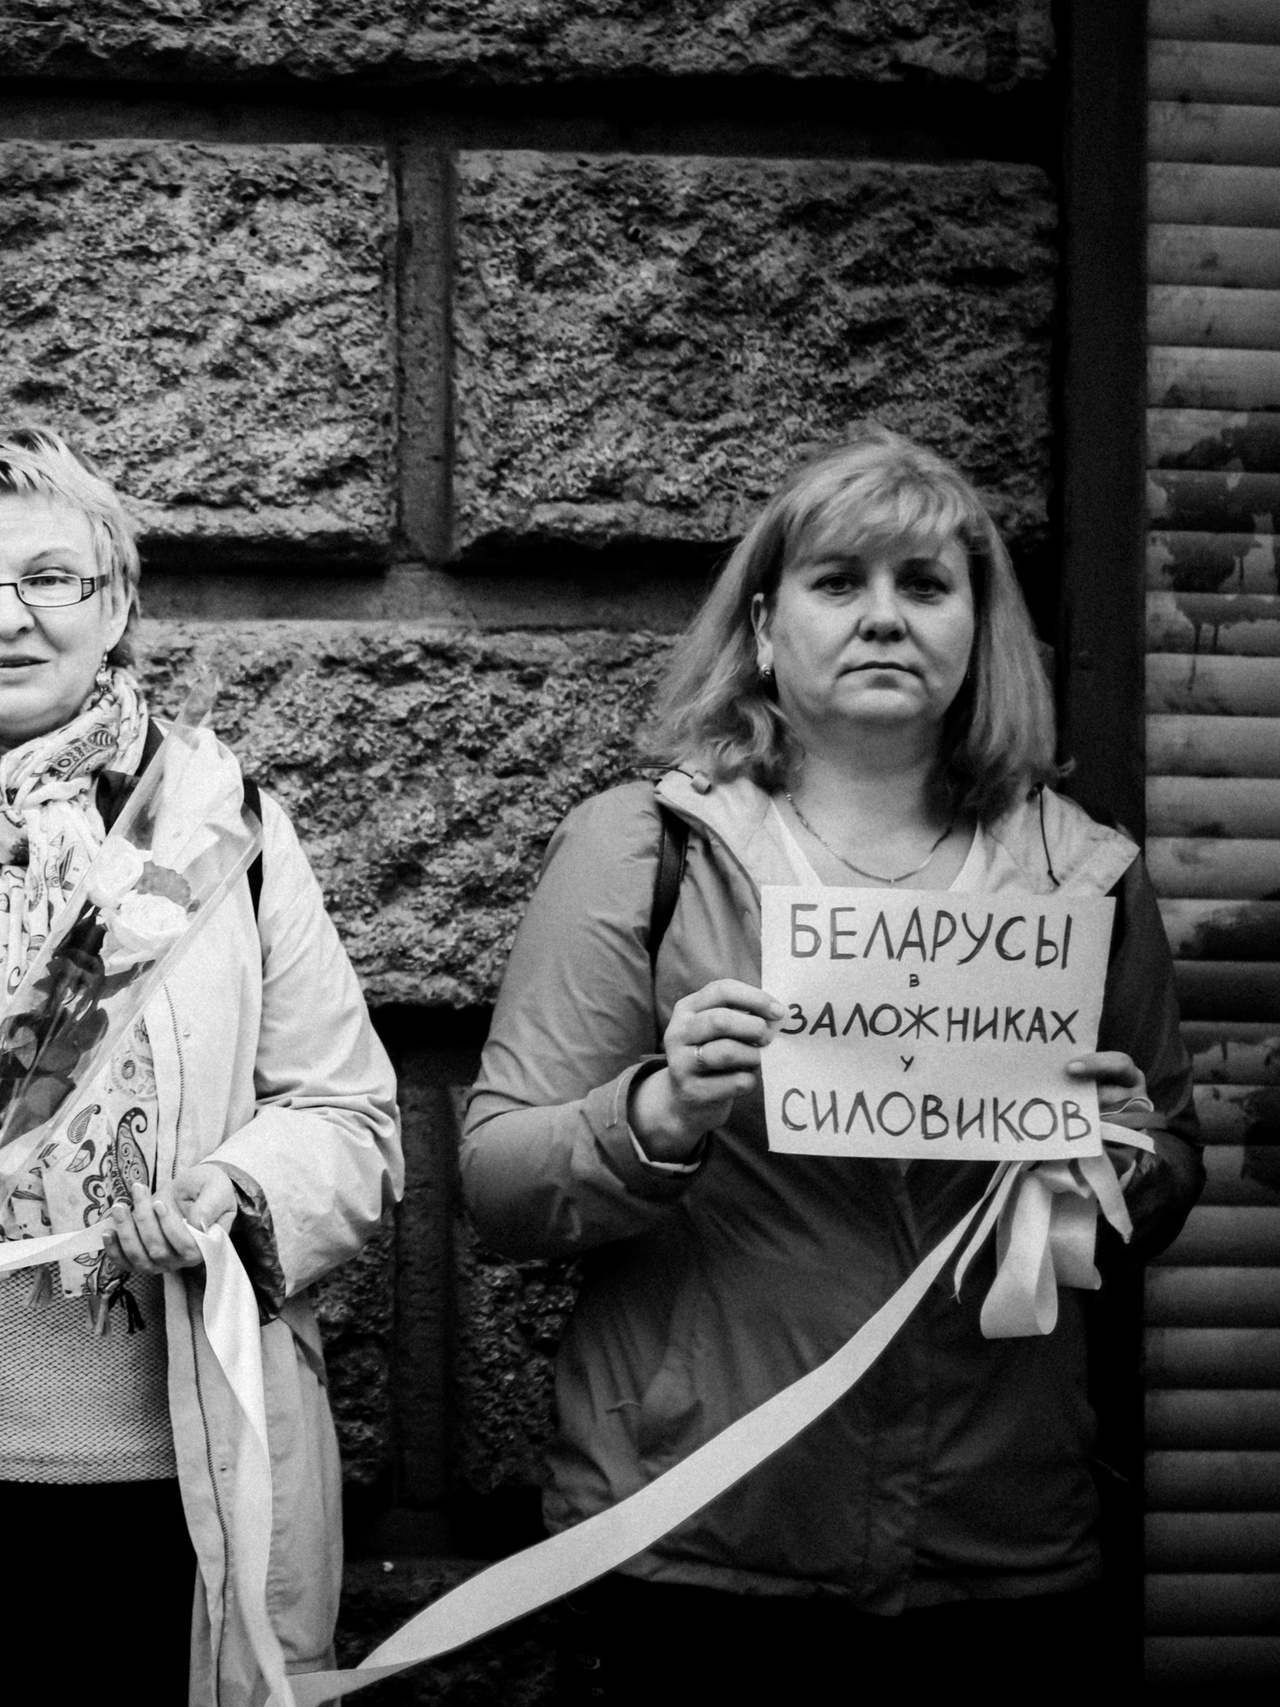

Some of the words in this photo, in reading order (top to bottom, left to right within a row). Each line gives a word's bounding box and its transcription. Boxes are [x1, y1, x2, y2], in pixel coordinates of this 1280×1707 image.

[790, 902, 1073, 970] БЕЛАРУСЫ
[779, 1001, 1080, 1044] ЗАЛОЖНИКАХ
[781, 1087, 1092, 1144] СИЛОВИКОВ
